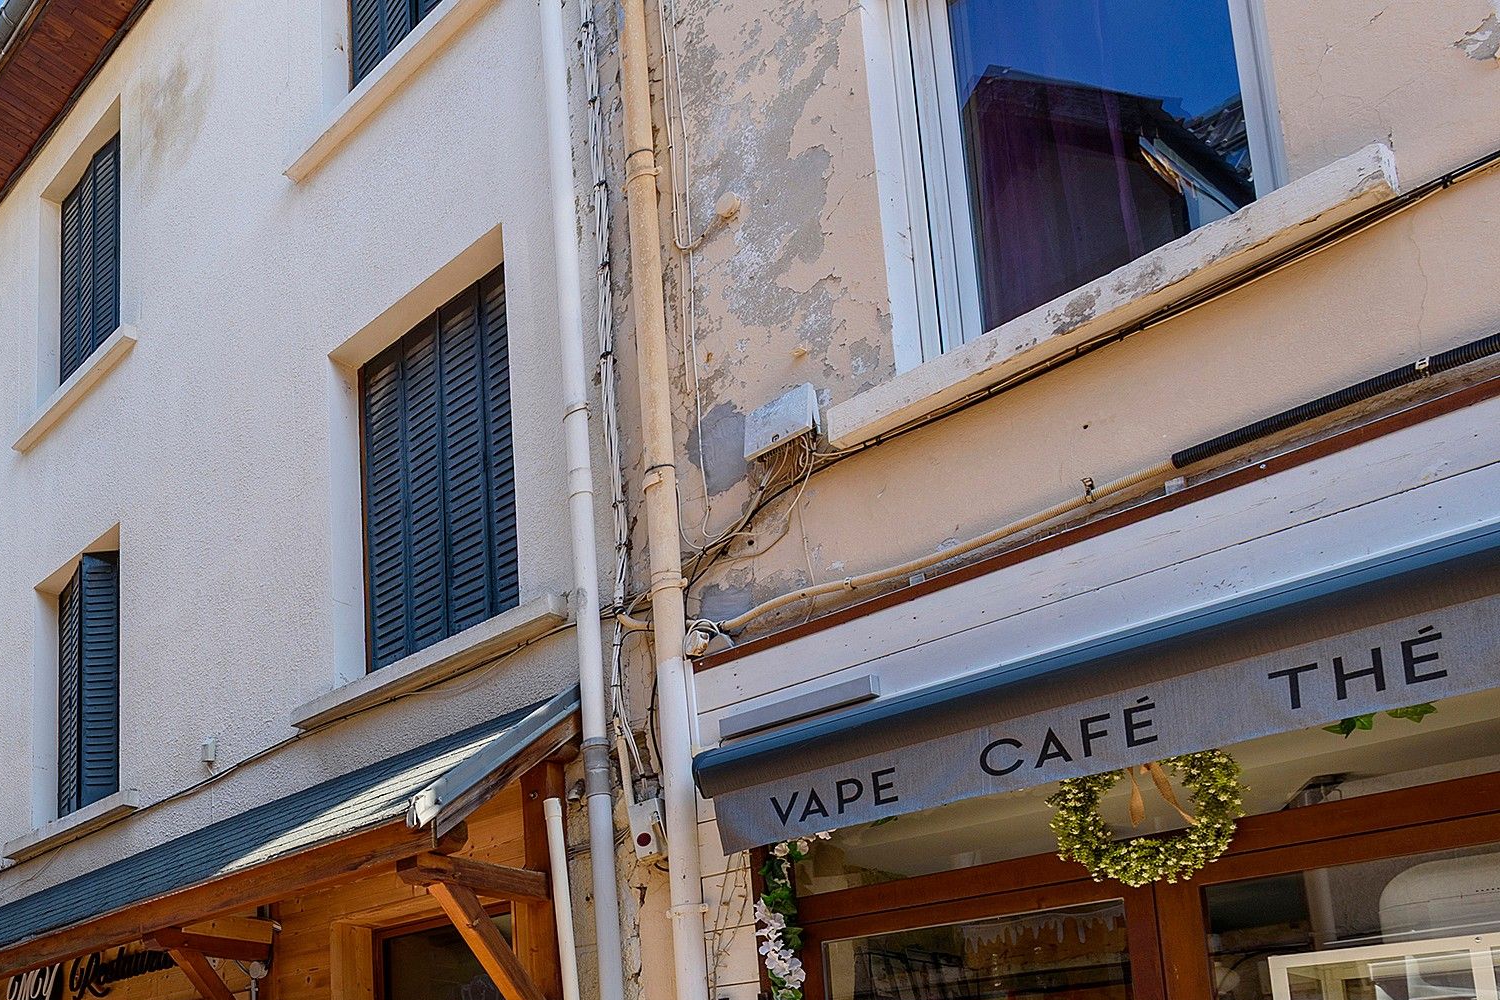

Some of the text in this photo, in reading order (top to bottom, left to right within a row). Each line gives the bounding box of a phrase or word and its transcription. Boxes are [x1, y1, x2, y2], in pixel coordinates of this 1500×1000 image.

[770, 625, 1449, 827] VAPE CAFÉ THÉ
